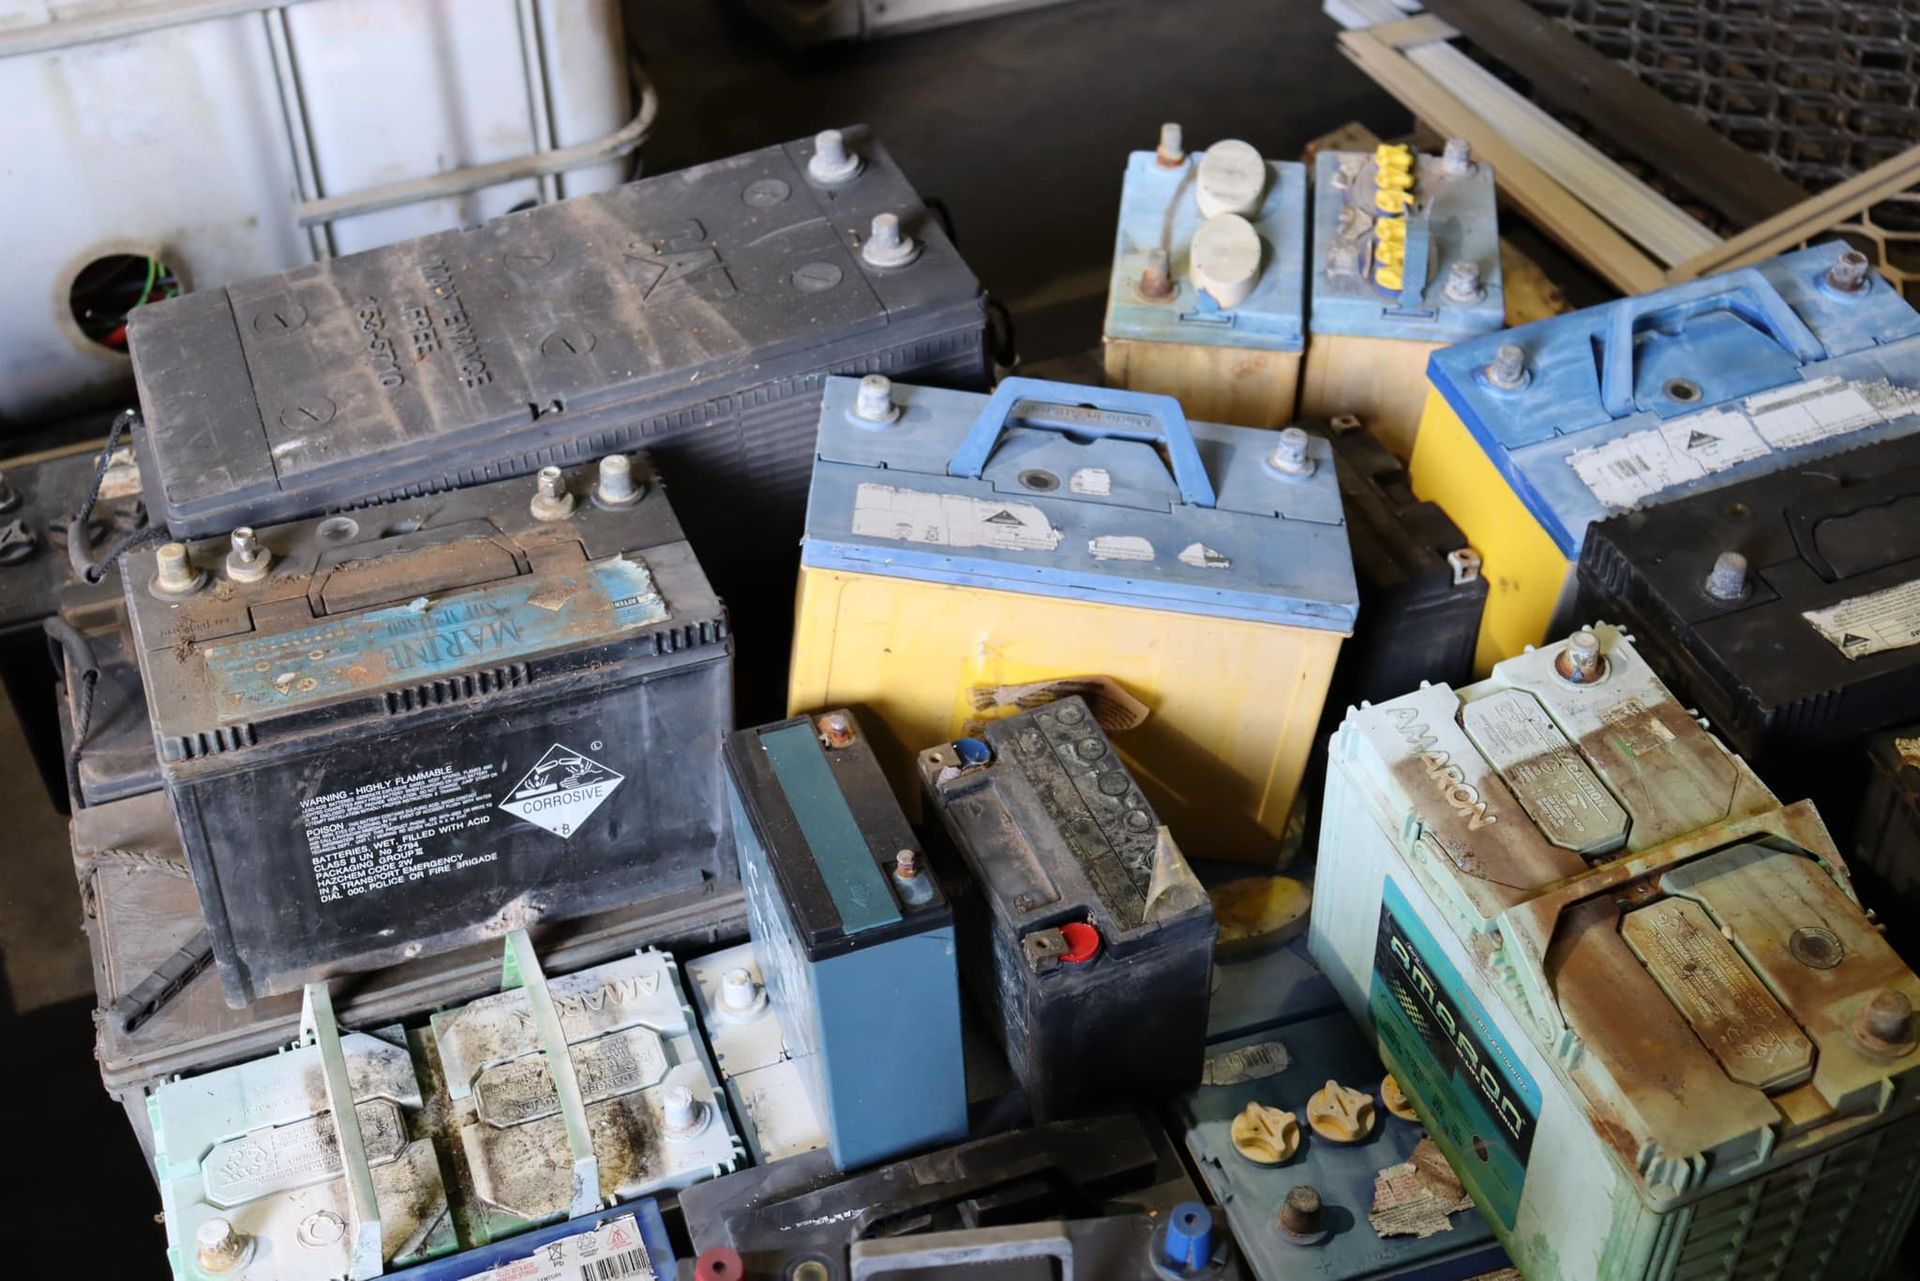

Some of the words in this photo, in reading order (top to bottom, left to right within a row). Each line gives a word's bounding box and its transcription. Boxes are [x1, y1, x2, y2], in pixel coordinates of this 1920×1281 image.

[401, 302, 444, 358] FREE
[380, 616, 524, 672] MARINE
[299, 790, 347, 808] WARNING
[355, 779, 392, 795] HIGHLY
[394, 765, 453, 785] FLAMMABLE
[1386, 705, 1498, 832] AMARON
[521, 785, 604, 814] CORROSIVE
[401, 828, 436, 843] FILLED
[438, 821, 464, 834] WITH
[466, 815, 490, 827] ACID
[313, 858, 347, 873] CLASS
[349, 856, 356, 864] 8
[358, 852, 374, 861] UN
[378, 847, 392, 856] No
[396, 840, 419, 852] 2794
[315, 859, 374, 880] PACKAGING
[316, 869, 366, 888] HAZCHEM
[367, 861, 396, 875] CODE
[397, 857, 413, 867] 2W
[318, 886, 330, 895] IN
[330, 883, 339, 892] A
[401, 853, 464, 874] EMERGENCY
[320, 890, 343, 903] DIAL
[368, 875, 405, 890] POLICE
[408, 870, 424, 880] OR
[428, 864, 451, 875] FIRE
[455, 852, 498, 869] BRIGADE
[509, 971, 661, 1032] AMARN
[553, 1260, 564, 1268] Pb
